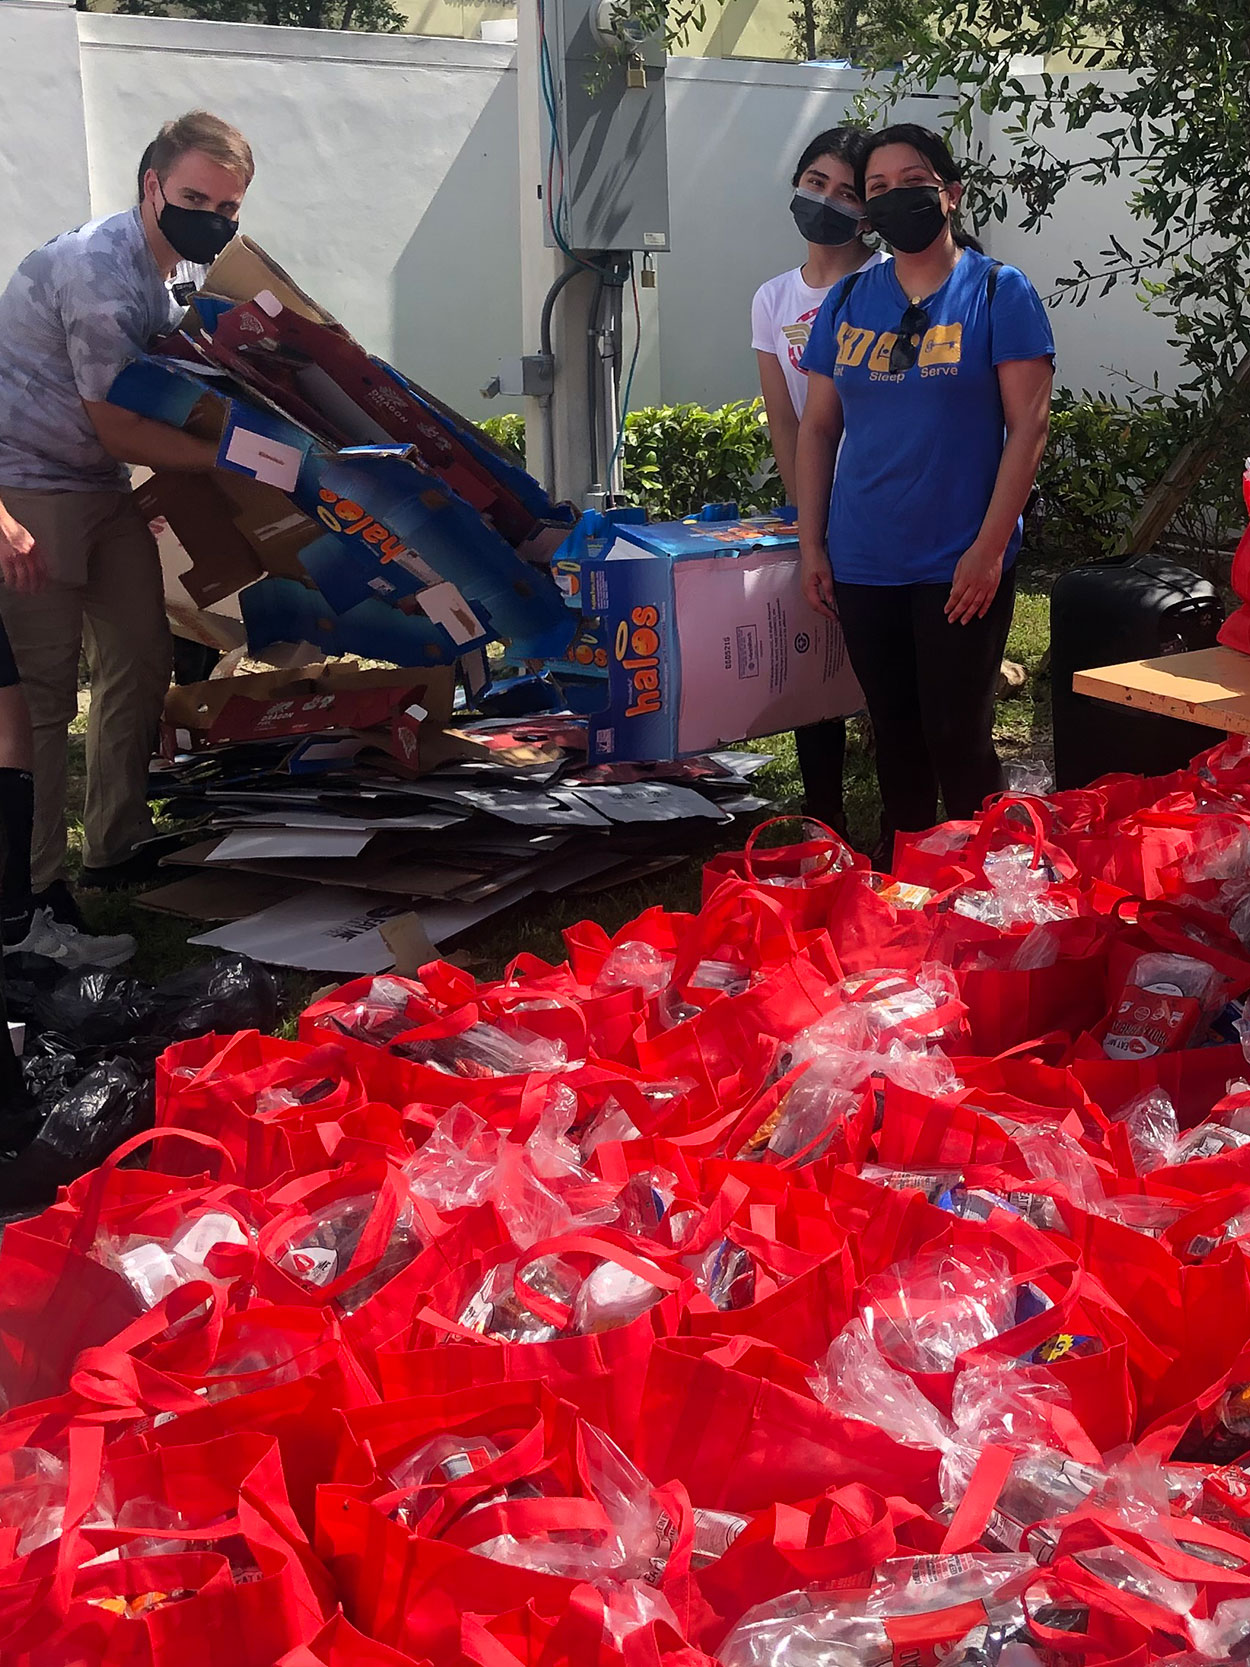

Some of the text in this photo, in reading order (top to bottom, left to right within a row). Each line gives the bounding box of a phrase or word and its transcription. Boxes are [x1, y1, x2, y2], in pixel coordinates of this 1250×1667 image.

[869, 372, 905, 383] Sleep
[921, 366, 958, 378] Serve
[370, 389, 409, 424] DRAGON
[616, 604, 664, 719] halos
[262, 711, 293, 722] DRAGON
[1117, 1041, 1129, 1051] EAT
